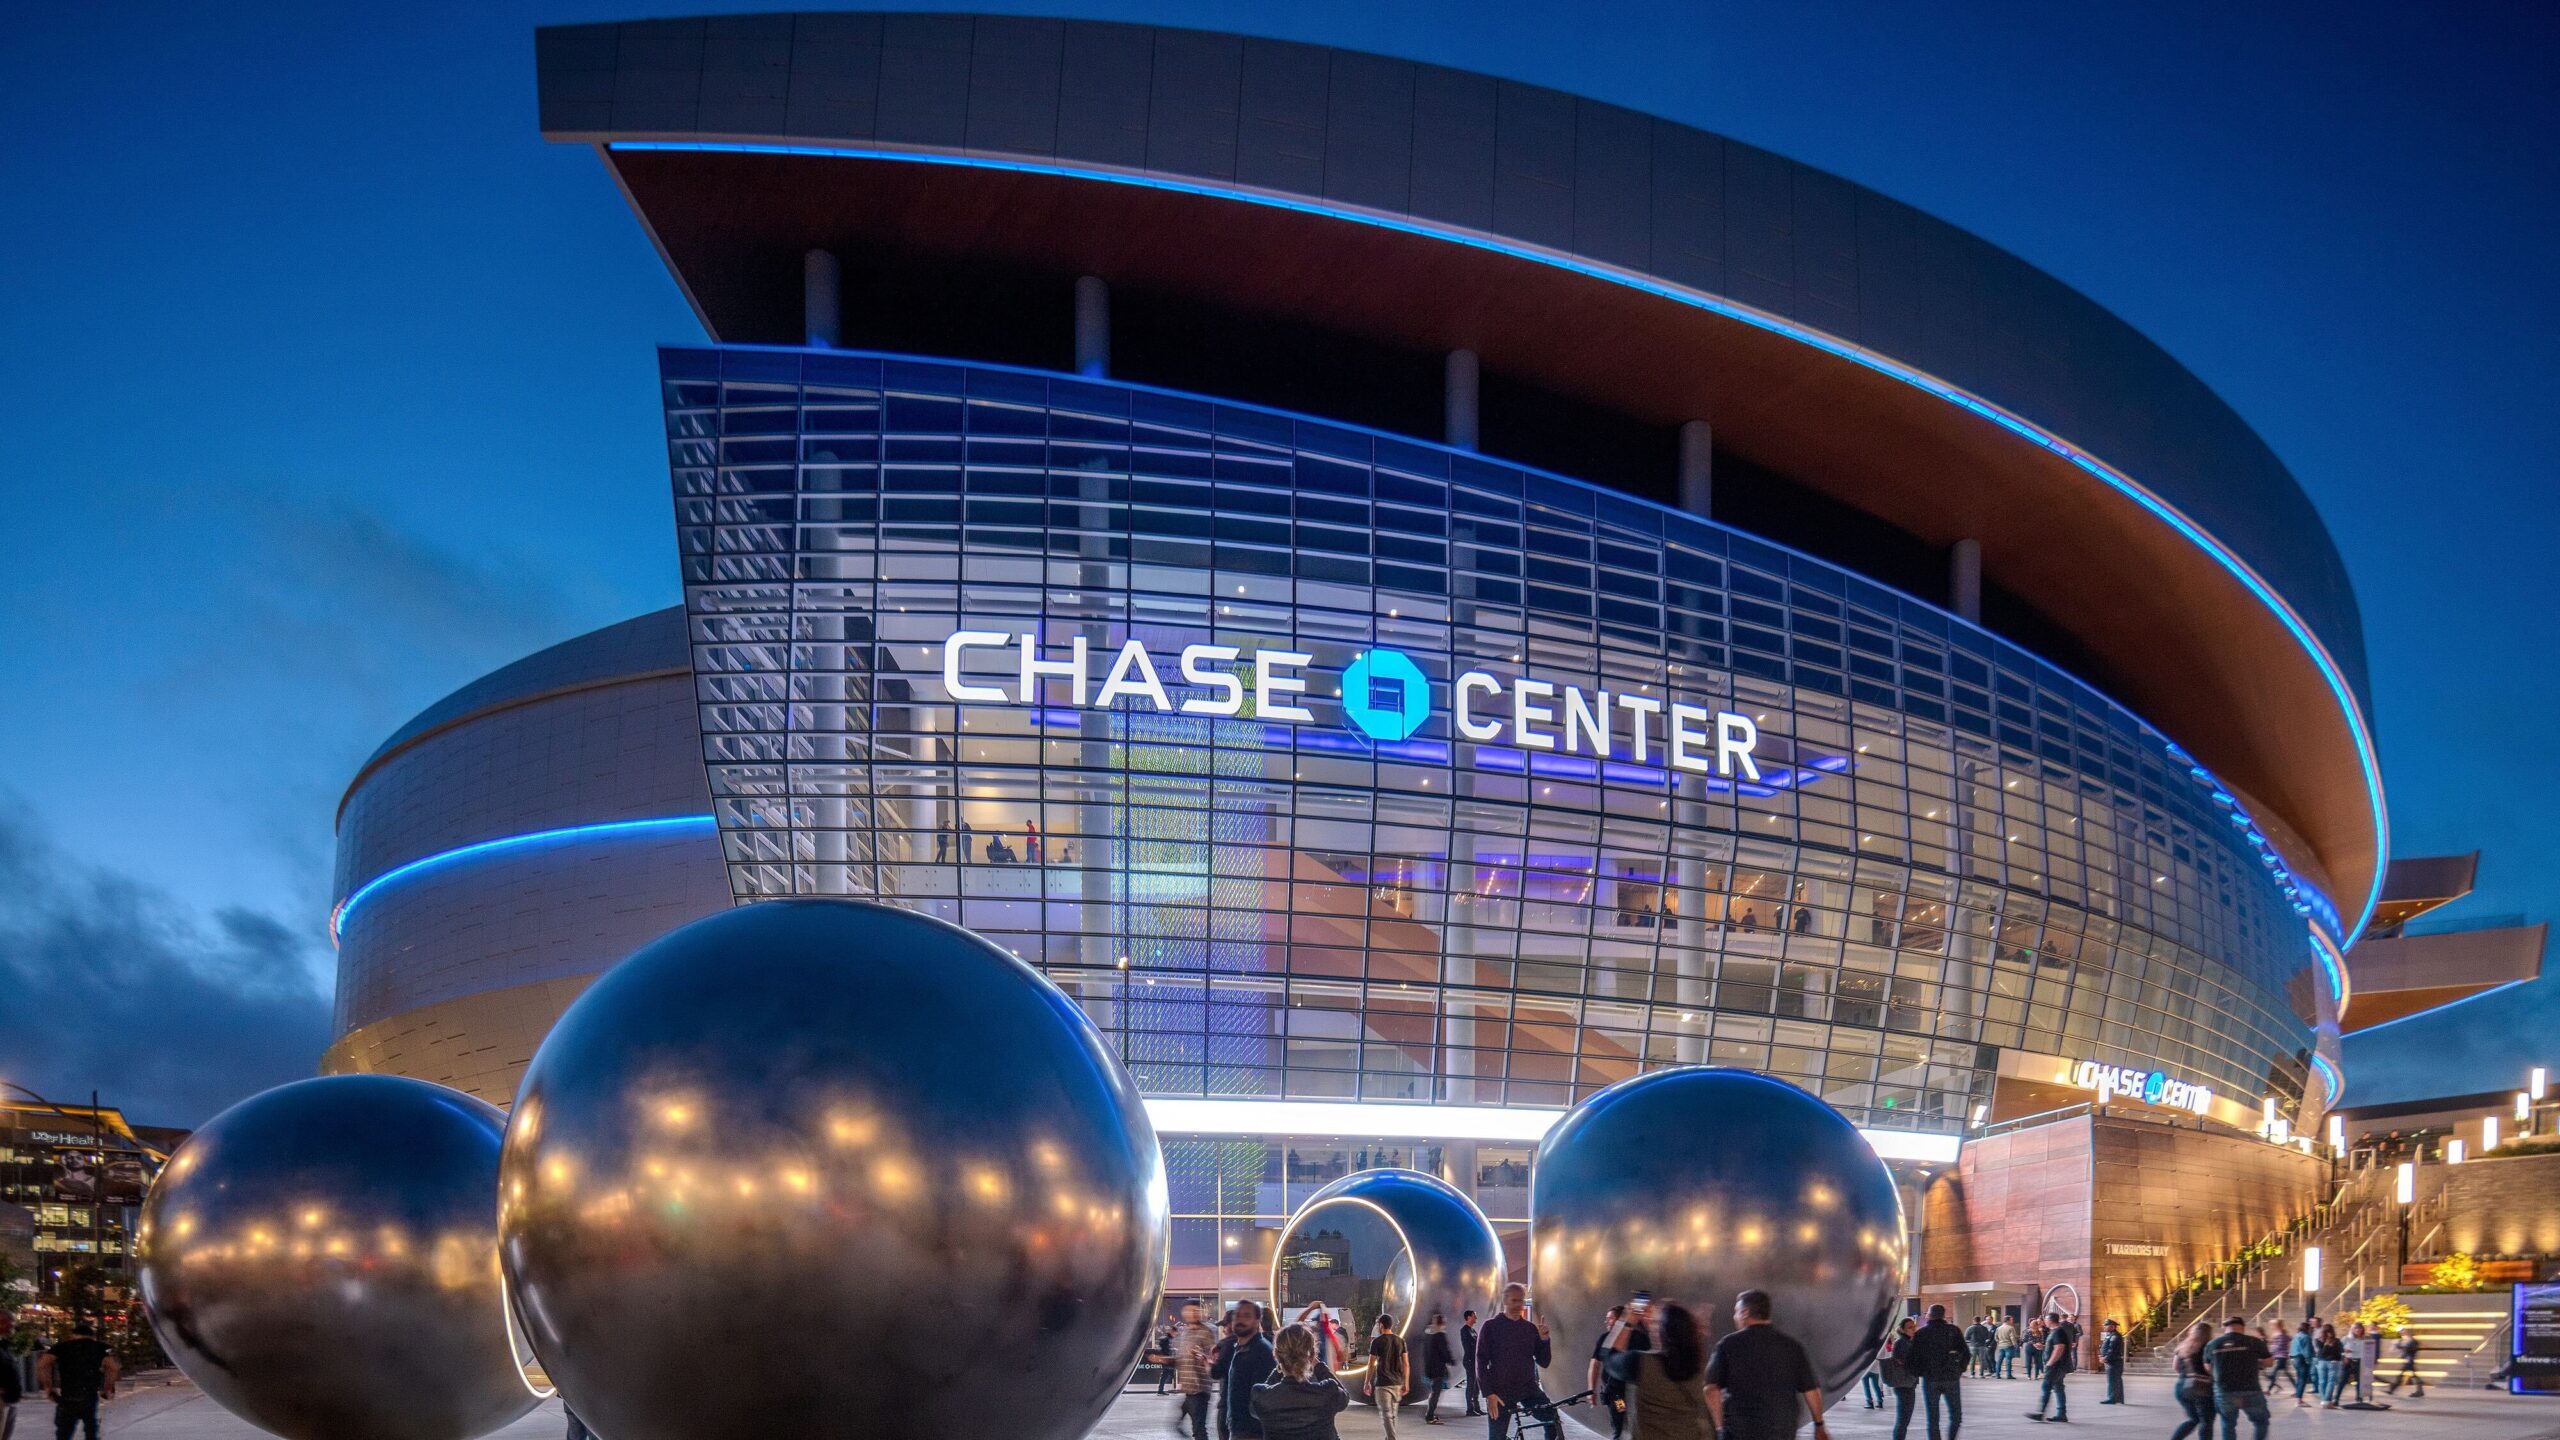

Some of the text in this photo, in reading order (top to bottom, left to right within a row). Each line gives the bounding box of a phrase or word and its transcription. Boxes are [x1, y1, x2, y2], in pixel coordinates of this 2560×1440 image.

[944, 631, 1761, 781] CHASE CENTER
[2078, 1060, 2212, 1114] CHASE CENT
[2104, 1243, 2170, 1257] 1 WARRIORS WAY
